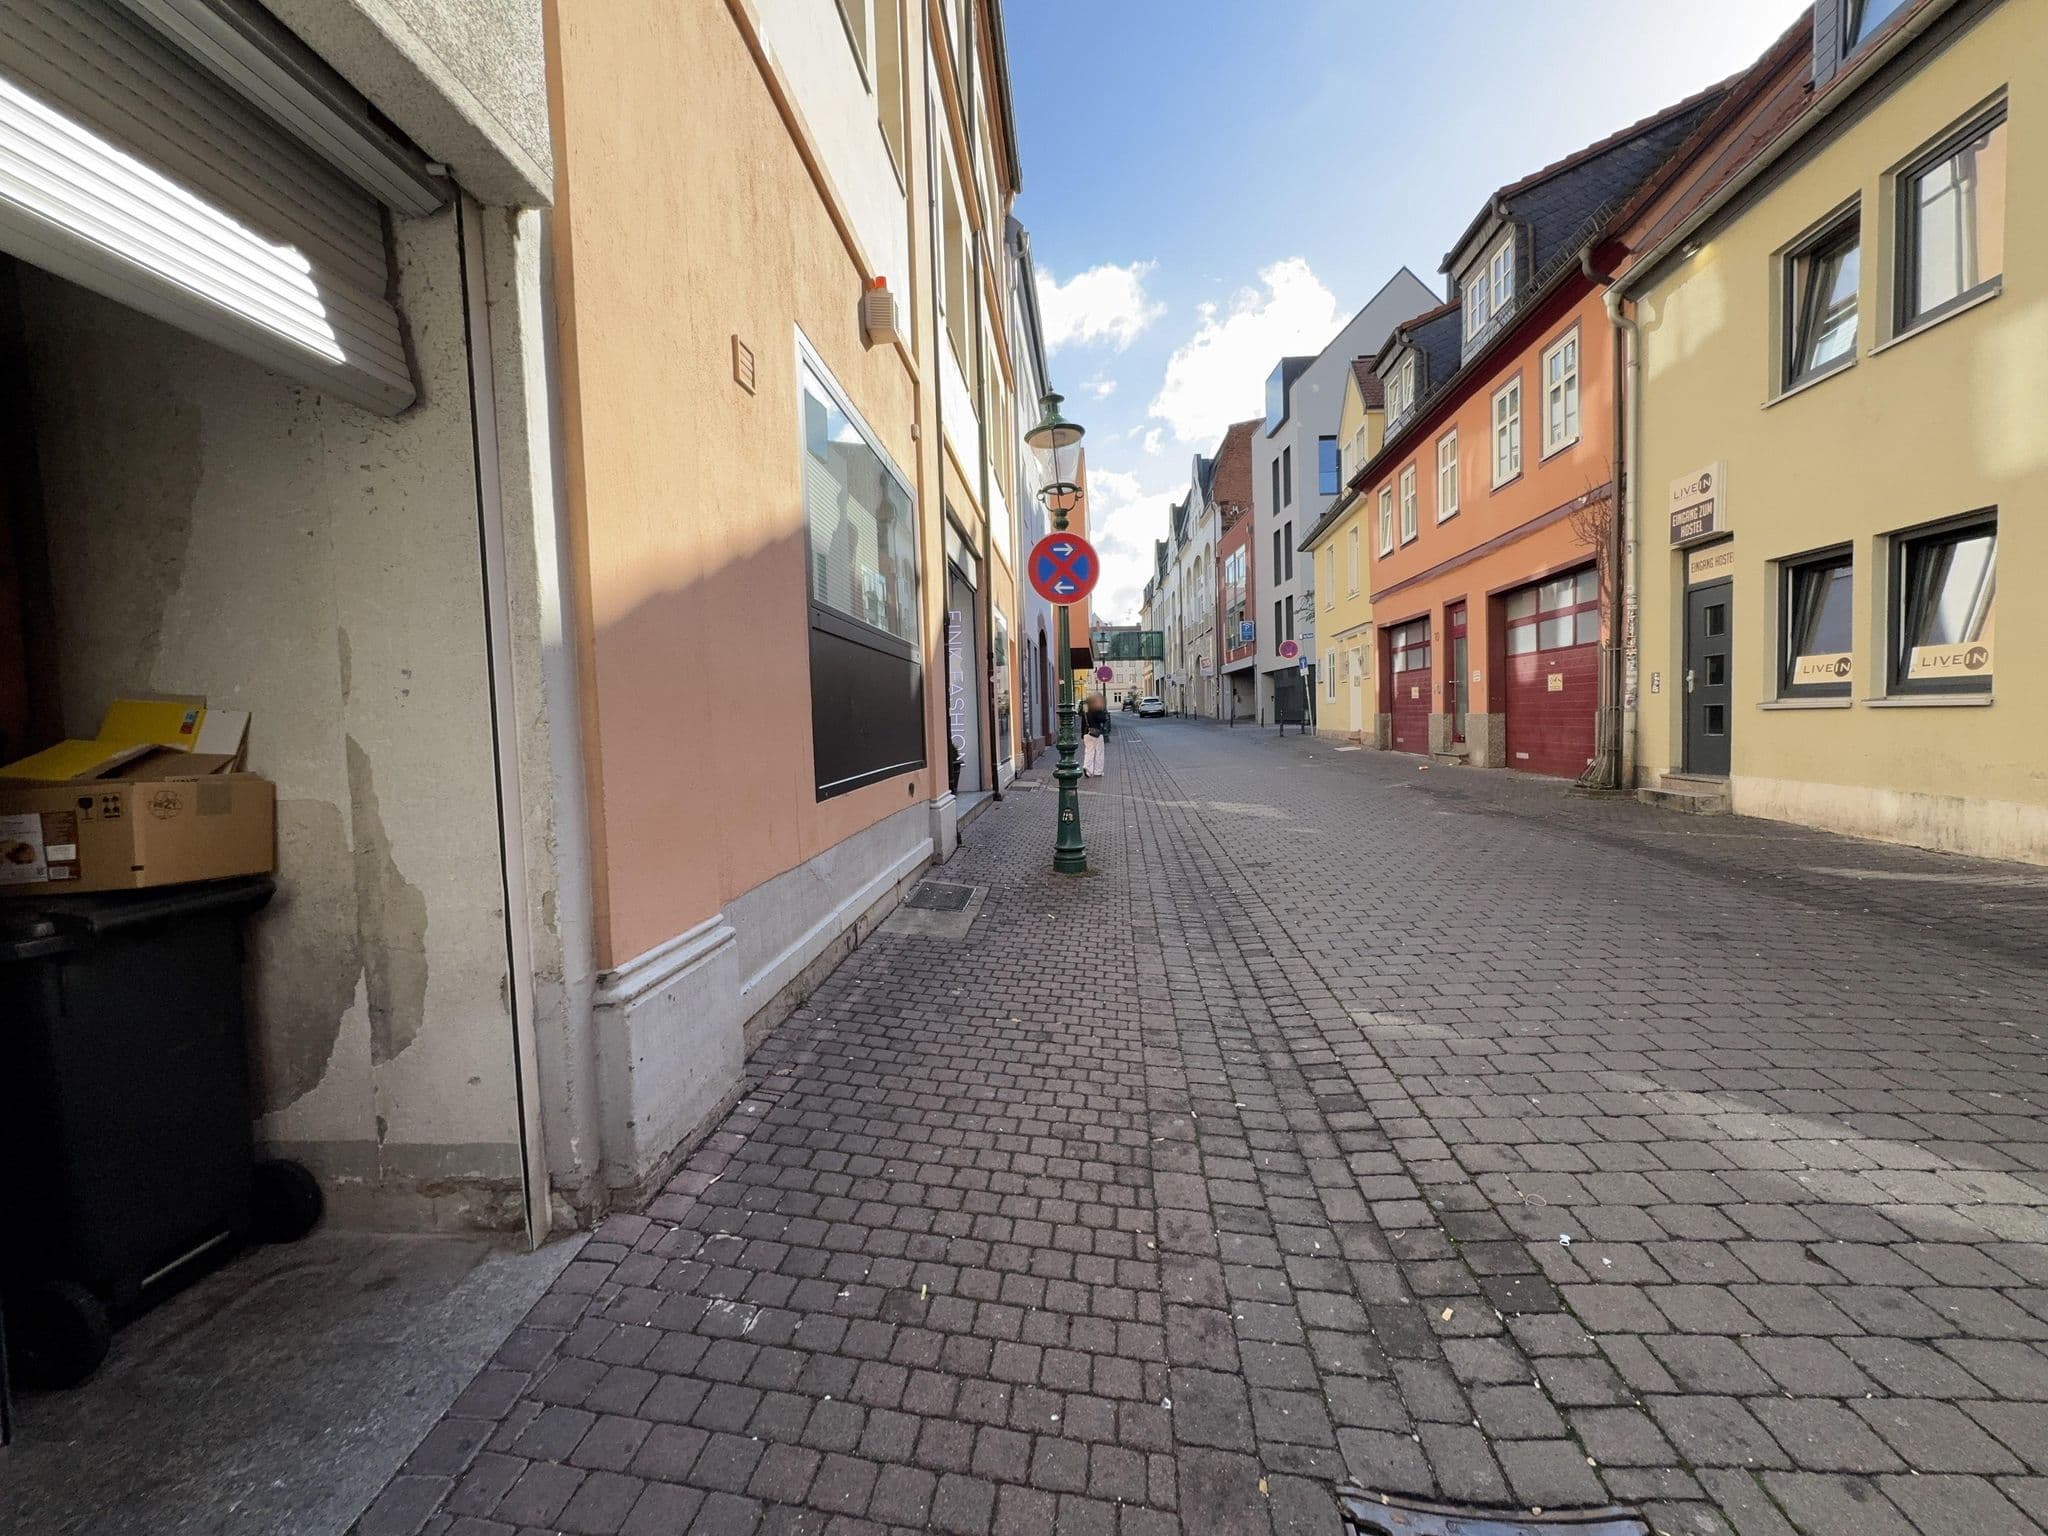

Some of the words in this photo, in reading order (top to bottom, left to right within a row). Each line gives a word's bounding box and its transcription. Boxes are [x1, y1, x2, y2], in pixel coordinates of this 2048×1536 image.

[1672, 507, 1698, 527] EINGANG
[1699, 501, 1713, 518] ZUM
[1680, 520, 1703, 538] HOSTEL
[1691, 557, 1714, 573] EINGANG
[1715, 551, 1734, 567] HOSTE
